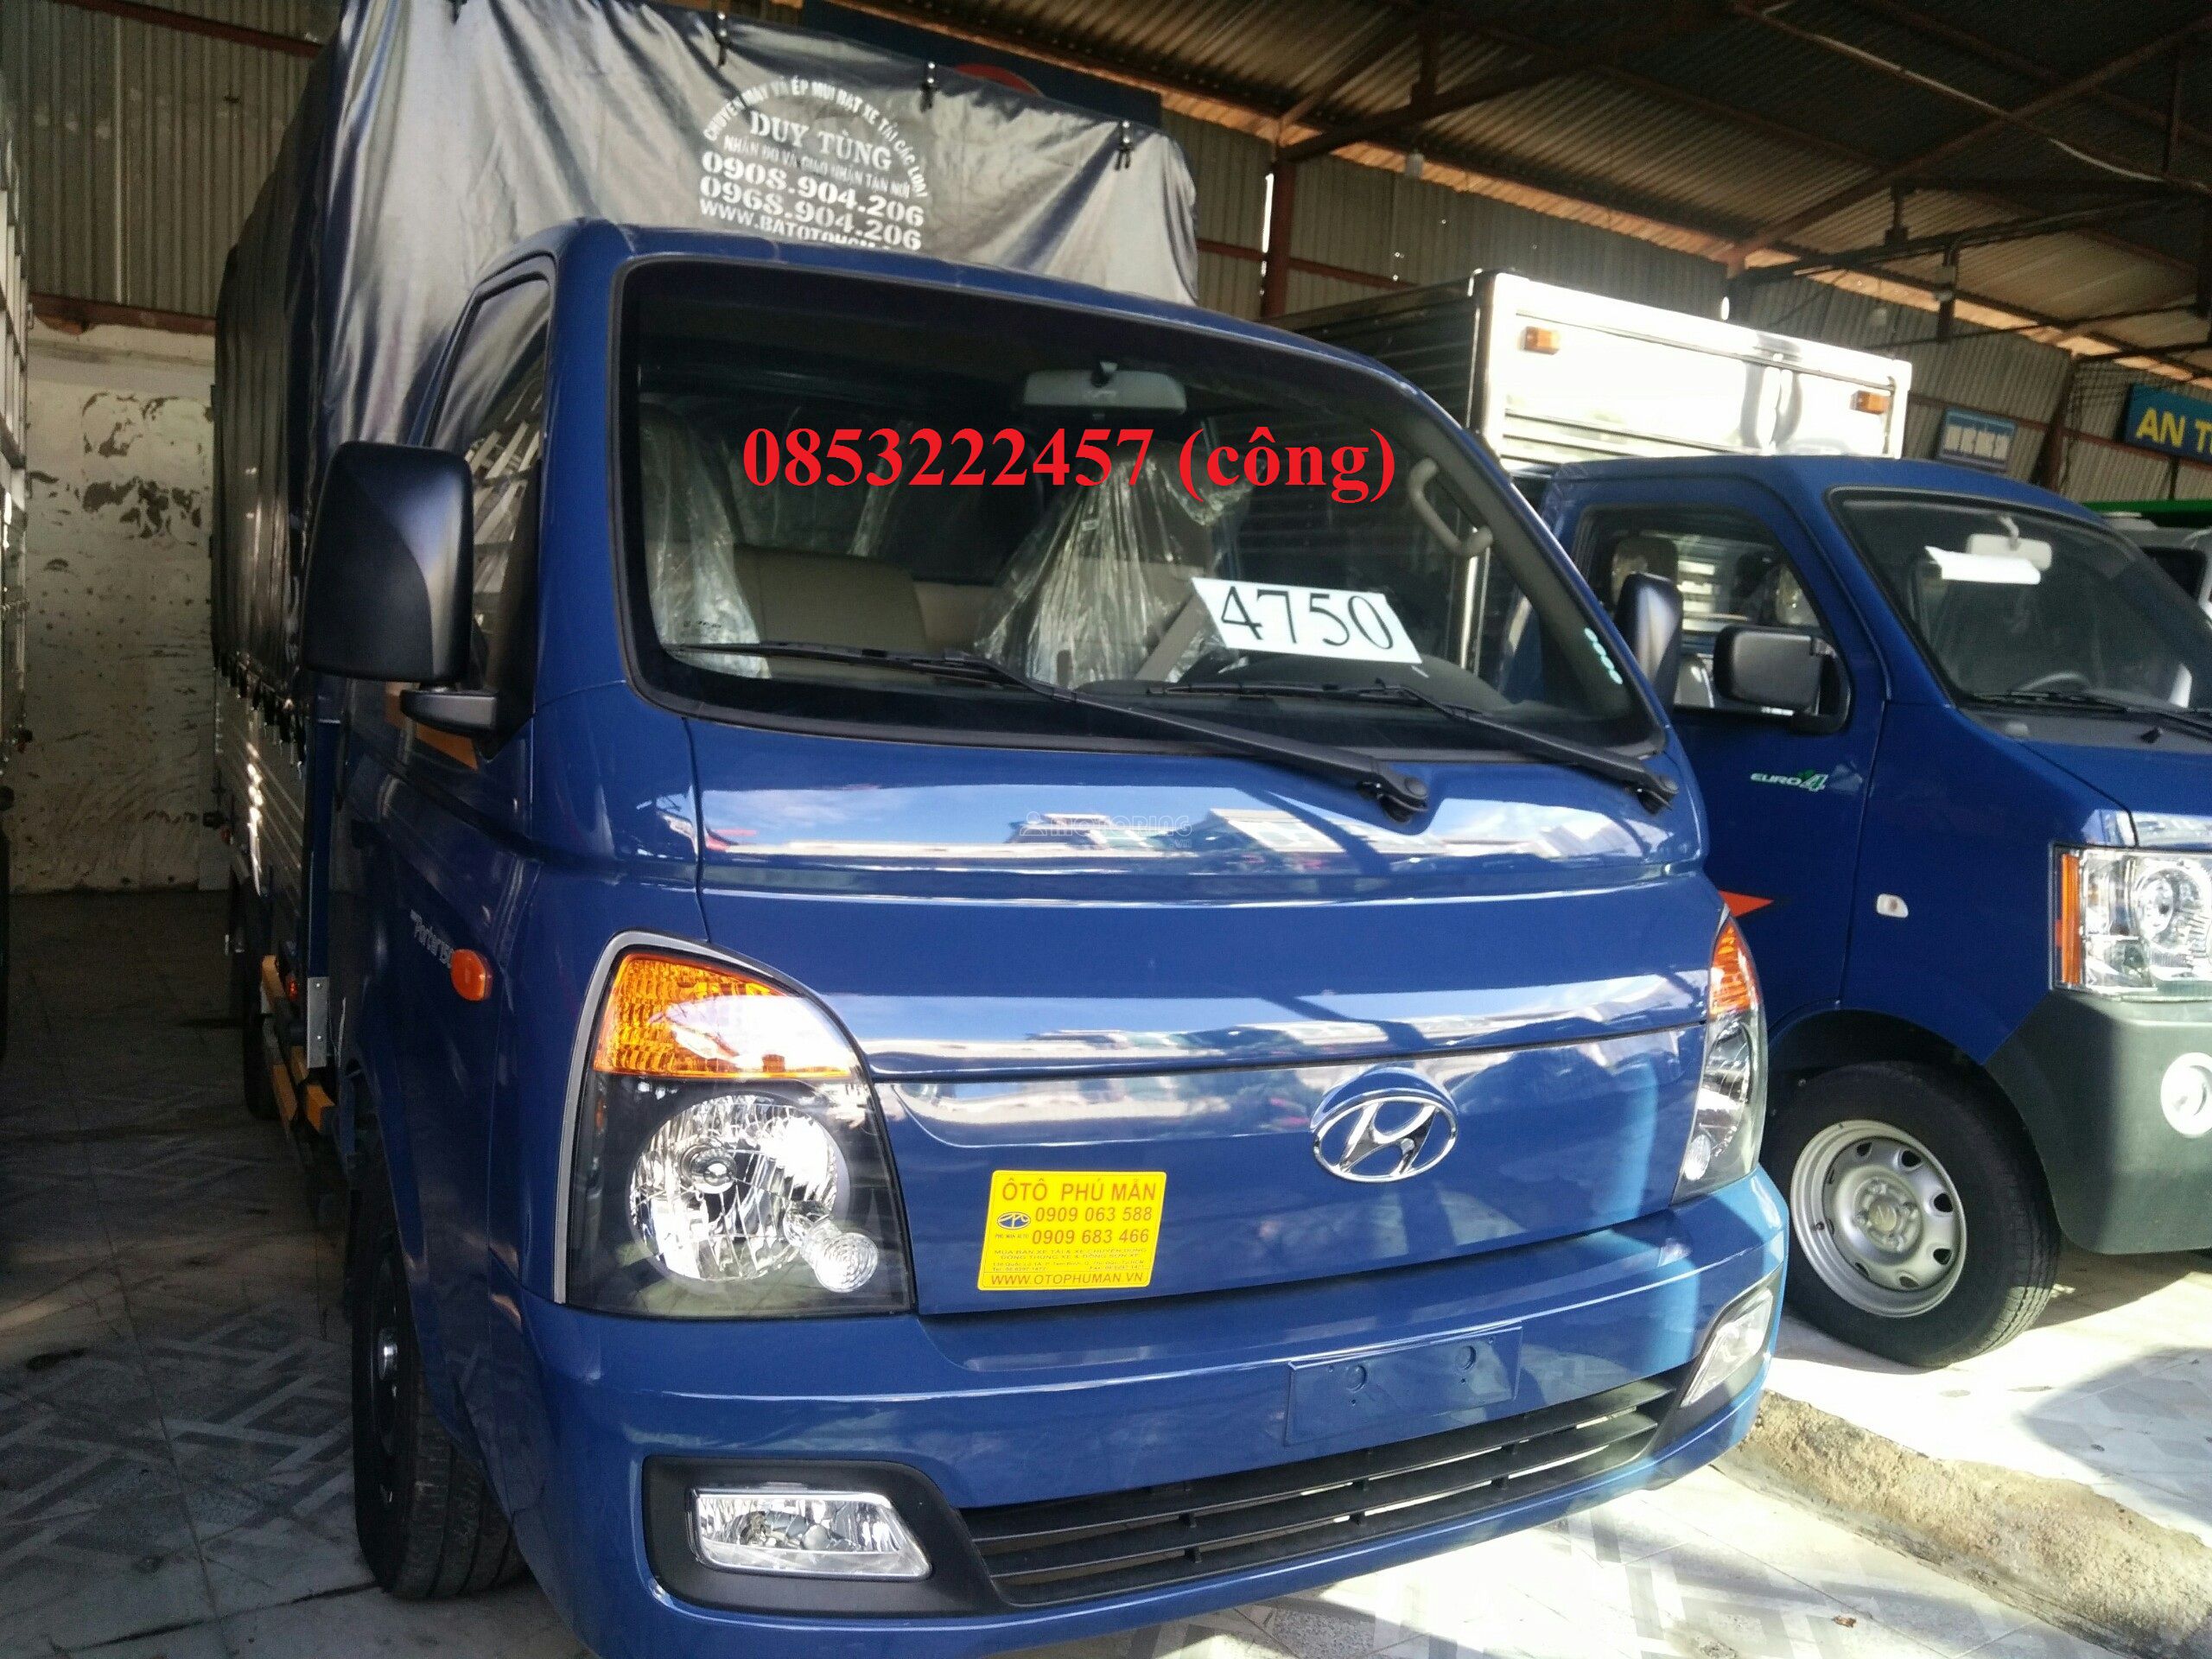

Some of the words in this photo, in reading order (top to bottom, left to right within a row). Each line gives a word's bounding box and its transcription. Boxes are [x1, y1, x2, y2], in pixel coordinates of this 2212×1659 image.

[749, 110, 810, 149] DUY
[702, 150, 925, 227] 0908.904.206
[699, 175, 922, 251] 0968.904.206
[2135, 407, 2186, 448] AN
[1220, 586, 1394, 650] 4750
[1002, 1178, 1048, 1202] ÔTÔ
[1060, 1178, 1104, 1202] PHÚ
[1035, 1206, 1078, 1223] 0909
[1084, 1206, 1116, 1222] 063
[1122, 1206, 1153, 1222] 588
[1032, 1230, 1075, 1245] 0909
[1081, 1229, 1113, 1244] 683
[1118, 1228, 1149, 1243] 466
